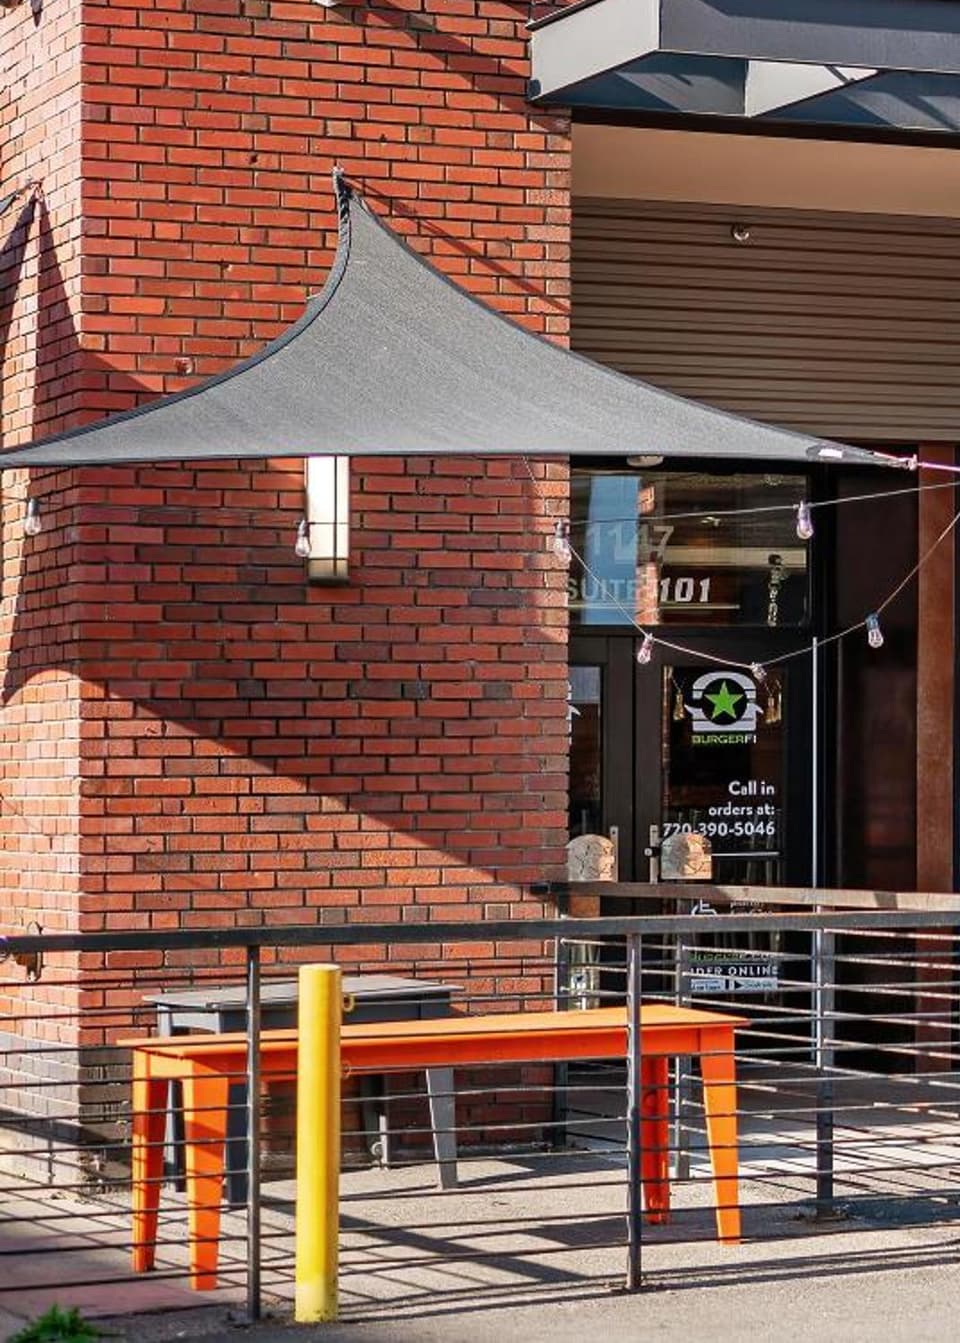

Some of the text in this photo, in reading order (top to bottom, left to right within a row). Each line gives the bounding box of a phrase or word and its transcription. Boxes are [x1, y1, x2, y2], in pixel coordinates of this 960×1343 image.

[660, 577, 711, 603] 101
[691, 734, 757, 745] BURGERFI
[728, 780, 775, 795] Call in
[708, 801, 775, 816] orders at:
[663, 821, 775, 837] 720-390-5046
[728, 966, 779, 977] ONLINE
